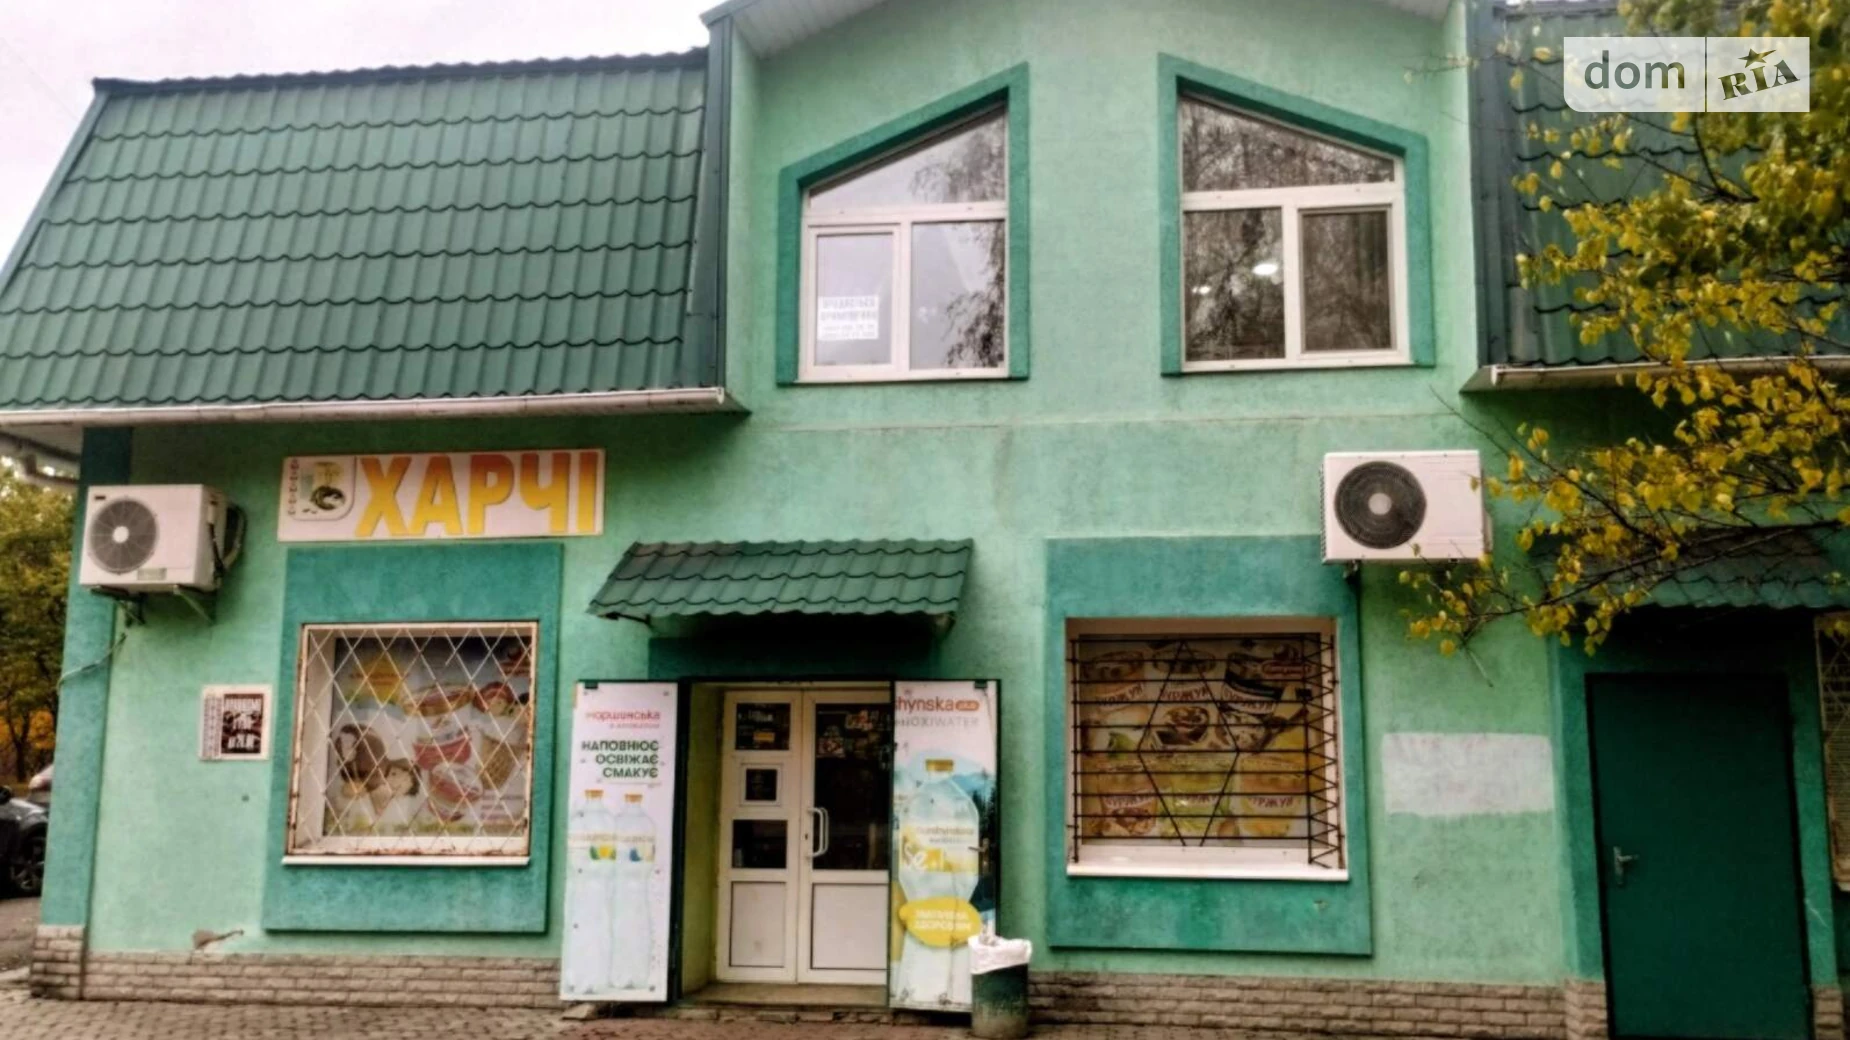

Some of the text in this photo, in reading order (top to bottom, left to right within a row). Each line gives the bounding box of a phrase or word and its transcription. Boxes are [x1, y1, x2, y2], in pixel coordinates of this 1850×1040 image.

[354, 452, 598, 537] ХАРЧІ
[582, 741, 659, 751] НАПОВНЮЄ
[595, 754, 659, 765] ОСВІЖАЄ
[603, 768, 658, 778] СМАКУЄ
